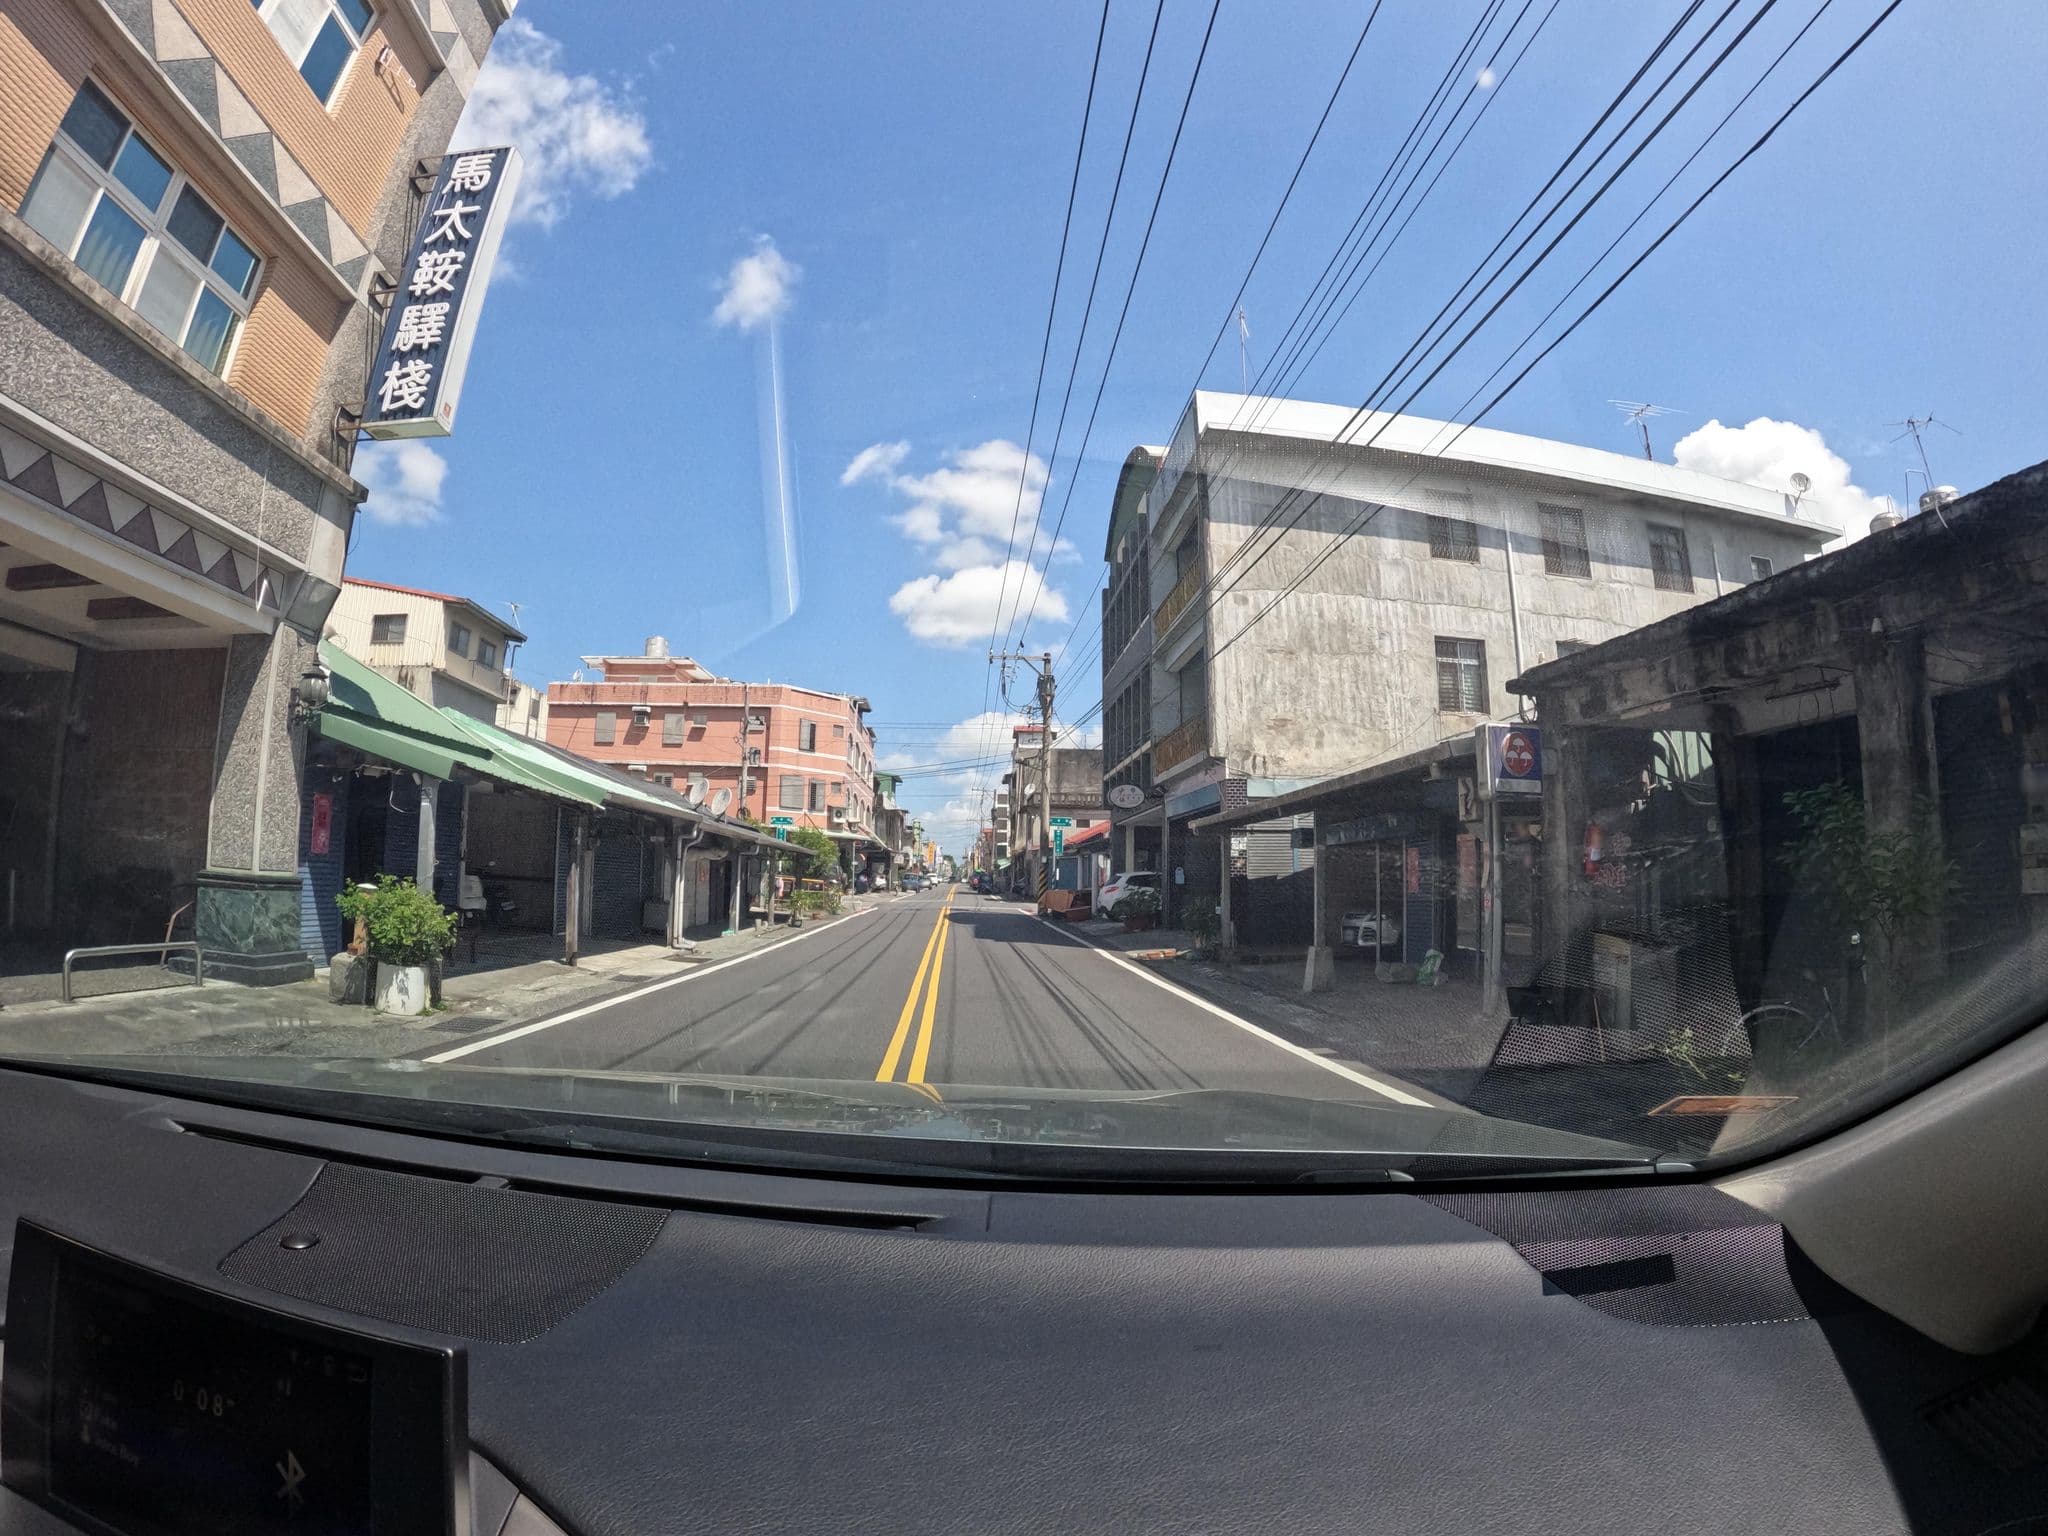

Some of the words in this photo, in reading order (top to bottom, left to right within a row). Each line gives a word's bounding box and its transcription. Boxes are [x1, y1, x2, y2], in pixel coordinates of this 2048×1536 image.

[379, 153, 496, 412] 馬太鞍驛棧
